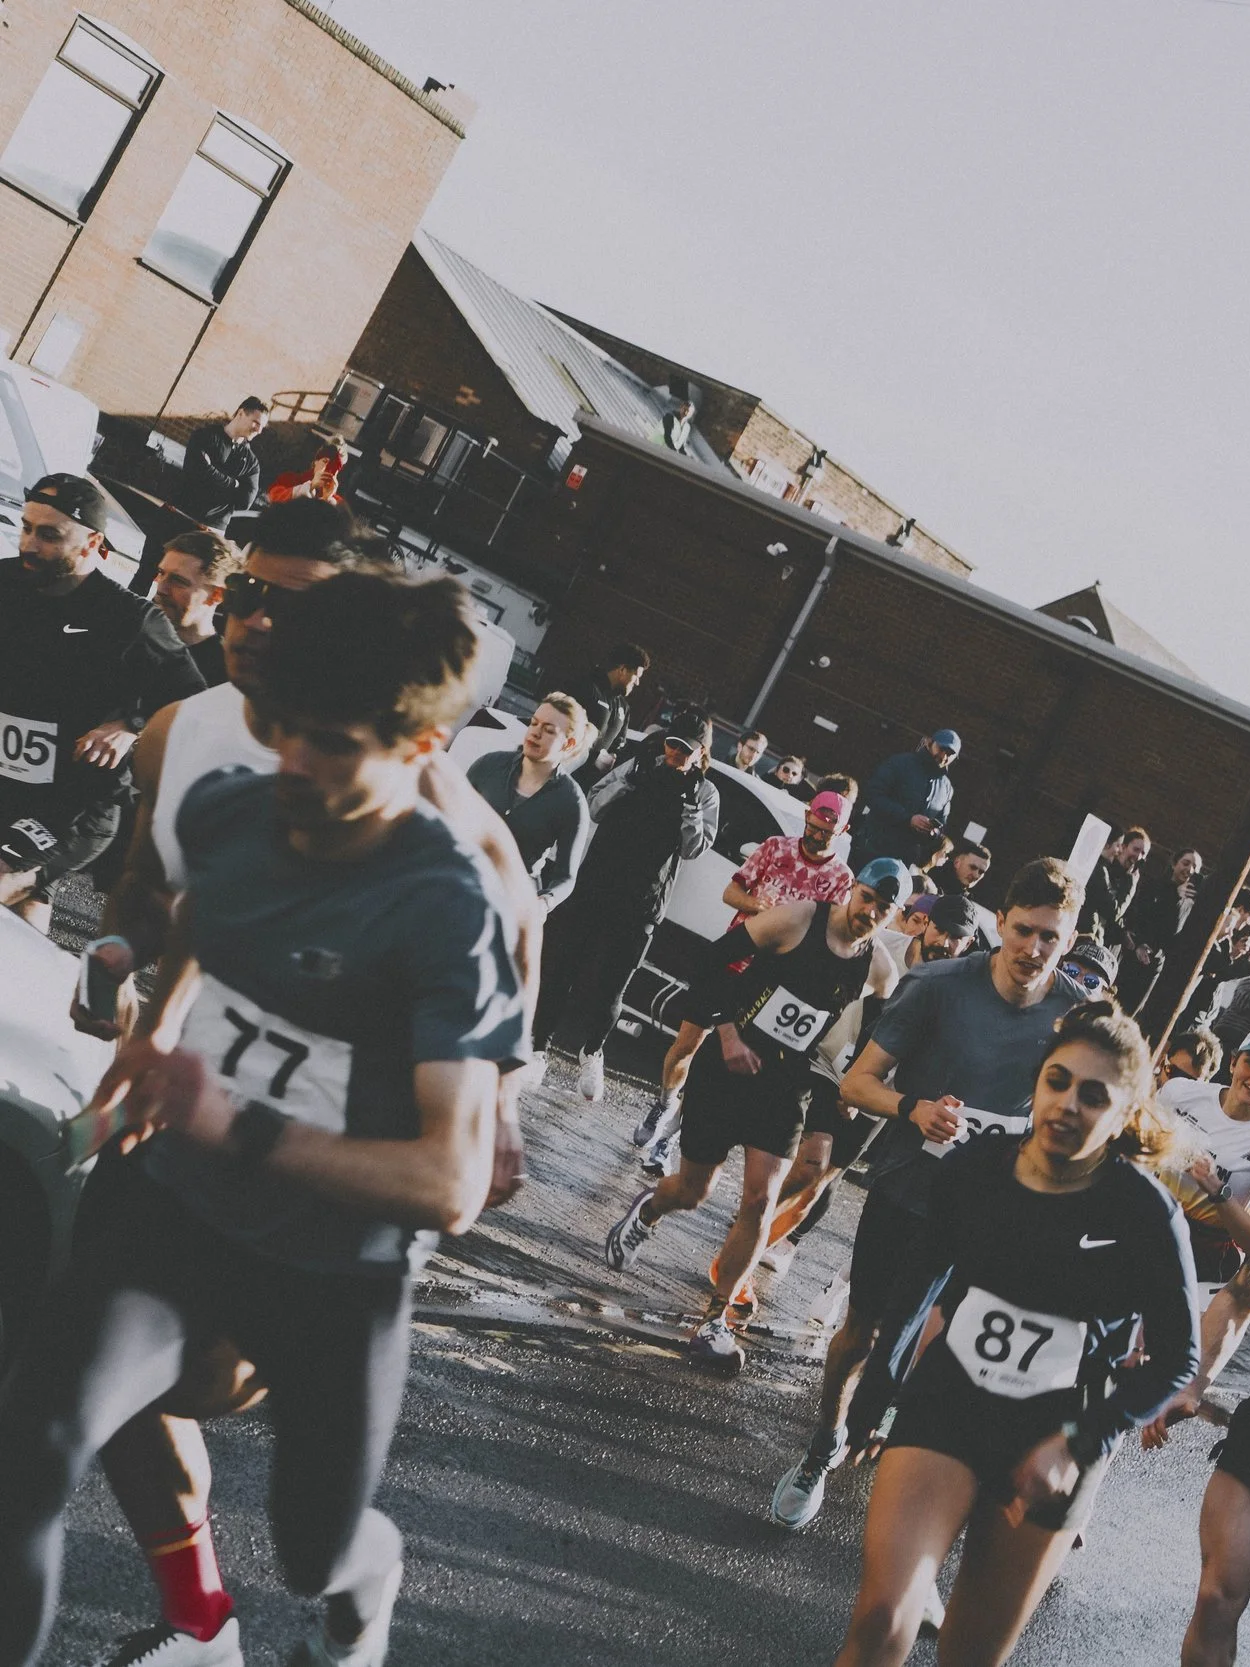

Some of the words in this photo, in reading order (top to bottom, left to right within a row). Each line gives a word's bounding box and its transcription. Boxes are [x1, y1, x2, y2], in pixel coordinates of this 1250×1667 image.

[775, 1002, 817, 1038] 96
[219, 1005, 310, 1100] 77
[975, 1310, 1054, 1373] 87
